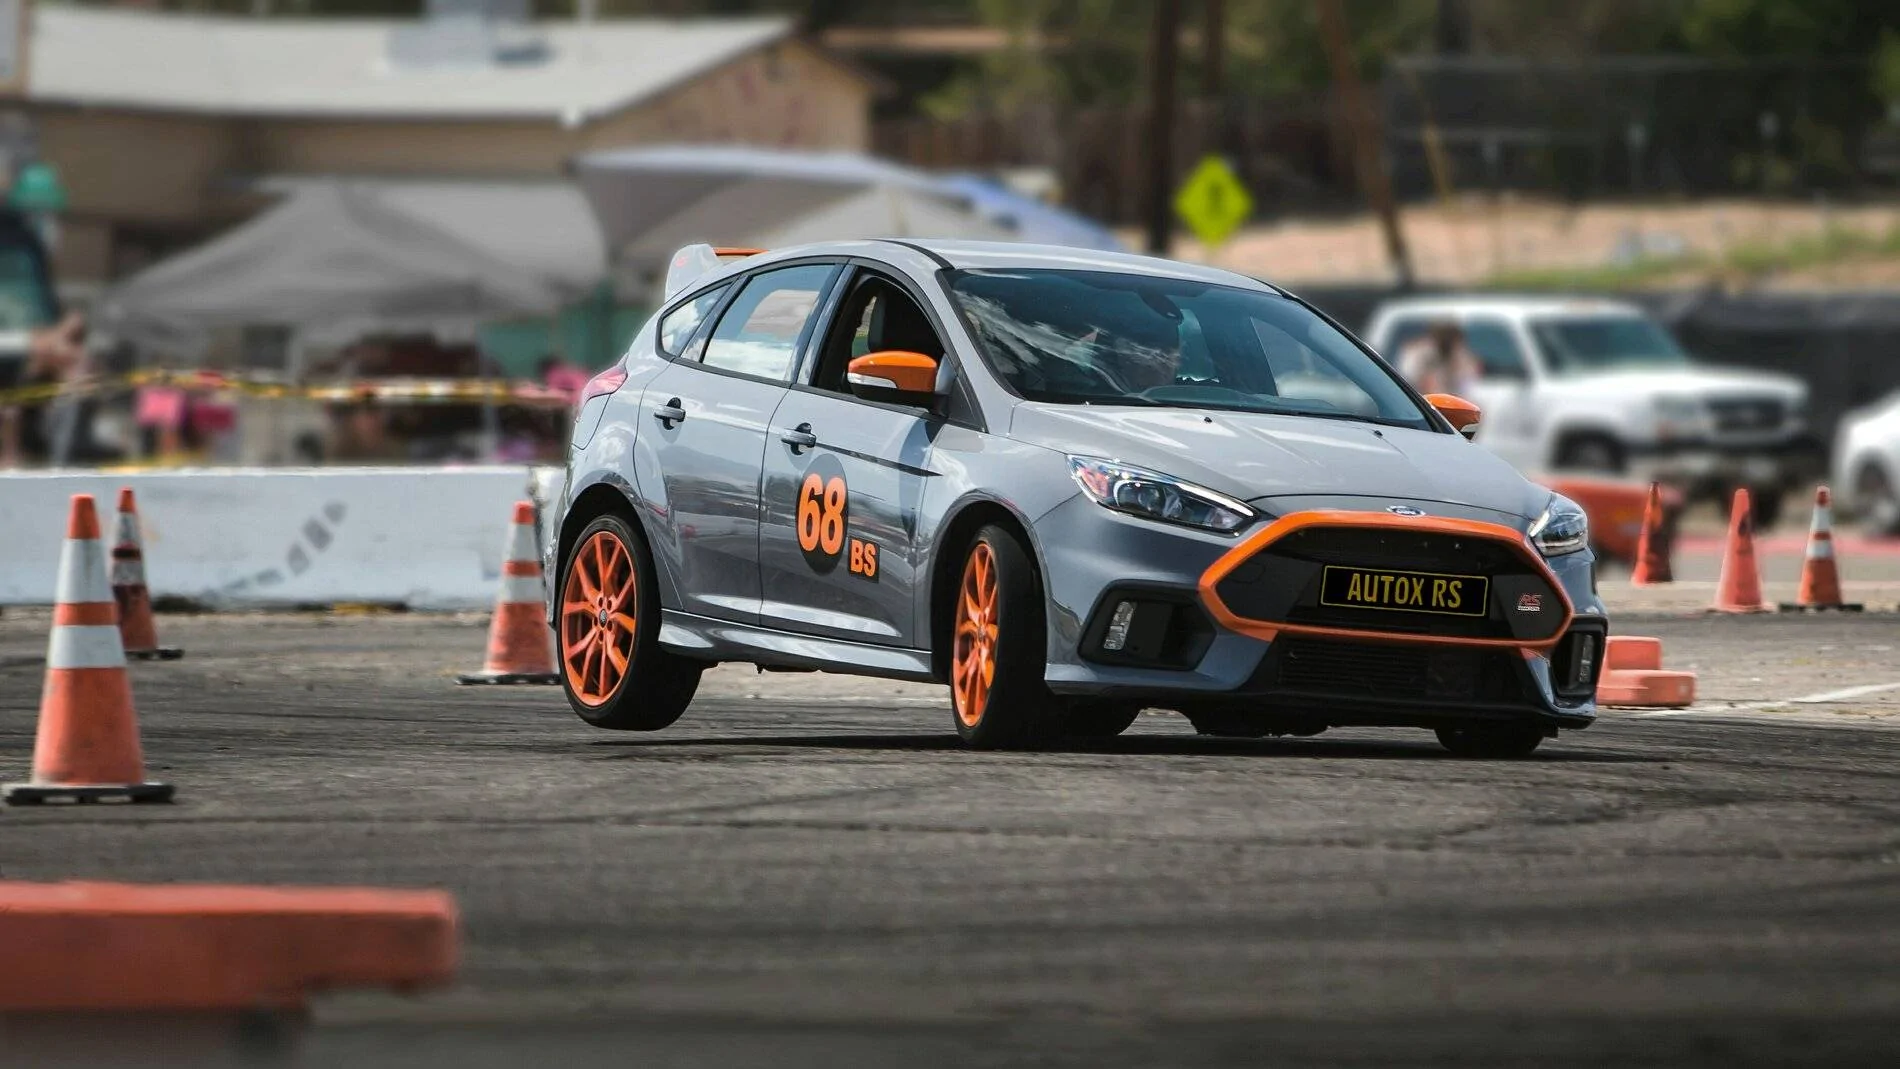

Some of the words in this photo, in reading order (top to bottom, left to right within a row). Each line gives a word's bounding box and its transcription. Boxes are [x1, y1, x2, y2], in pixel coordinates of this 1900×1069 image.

[798, 473, 846, 554] 68
[850, 539, 876, 577] BS
[1347, 573, 1425, 606] AUTOX
[1431, 579, 1462, 608] RS
